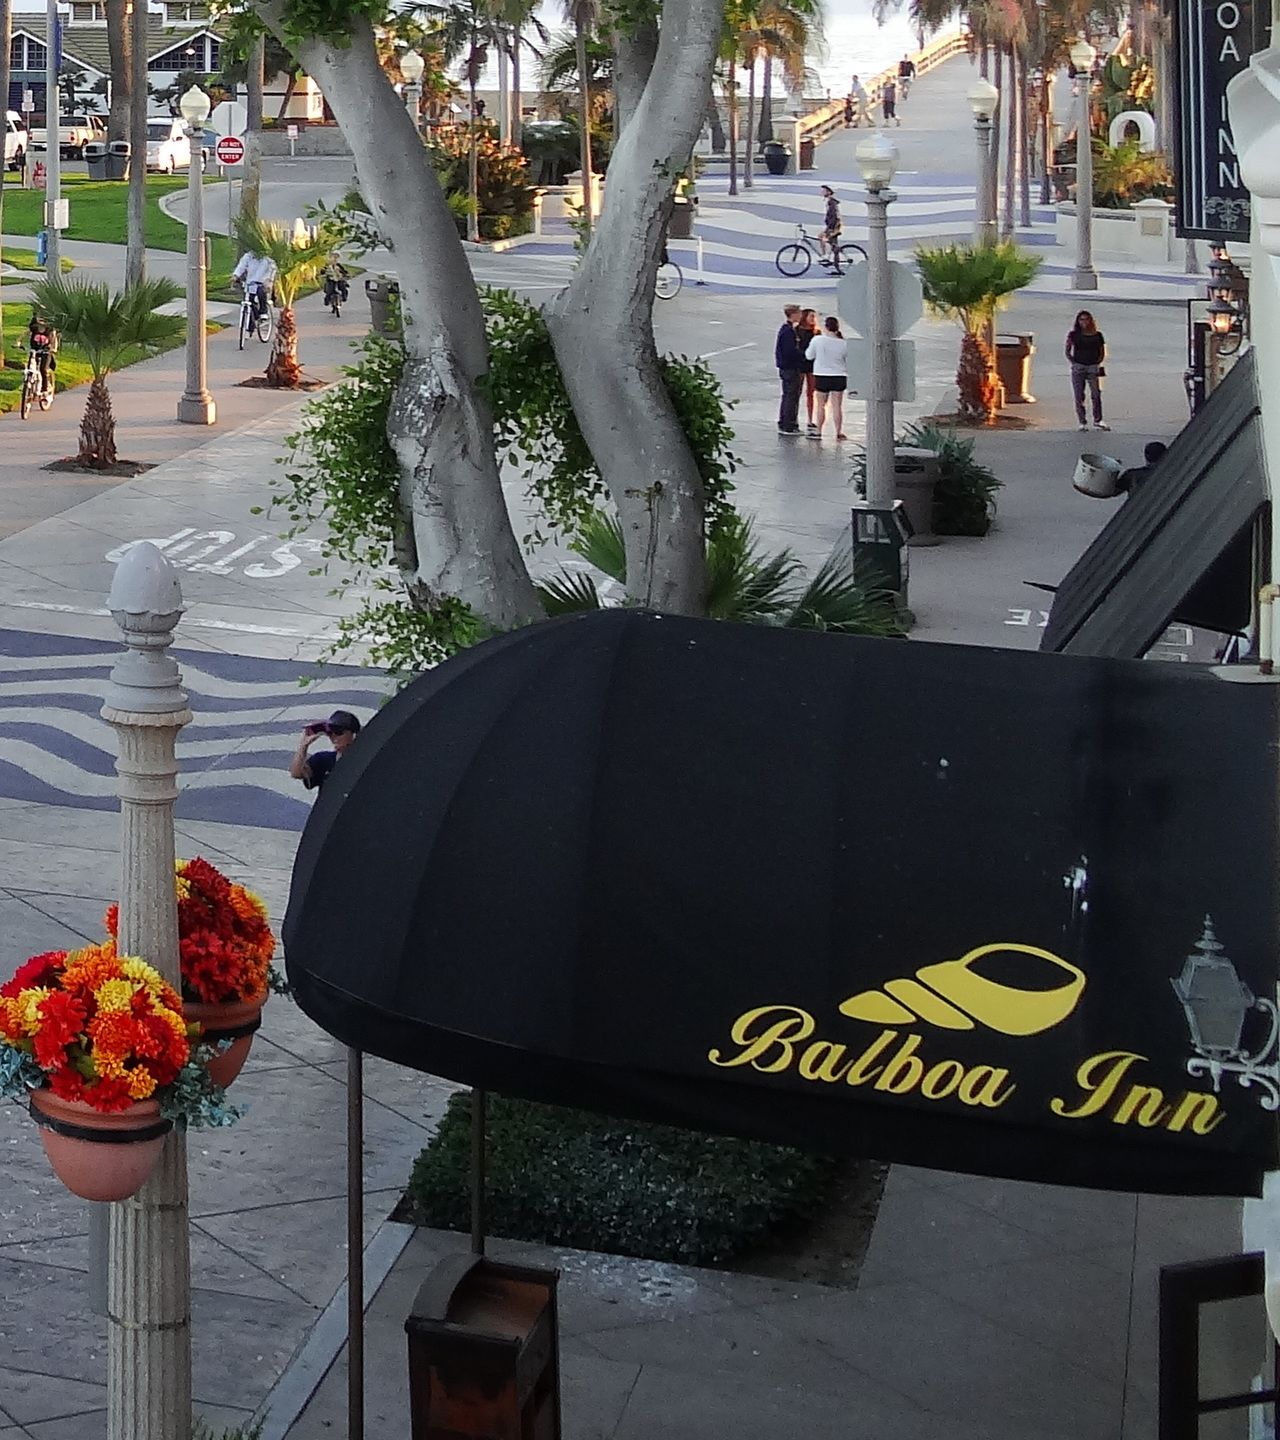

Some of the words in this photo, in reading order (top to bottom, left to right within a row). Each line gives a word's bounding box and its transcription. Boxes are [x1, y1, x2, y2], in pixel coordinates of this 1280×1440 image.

[1218, 95, 1239, 189] INN
[708, 1004, 1016, 1108] Balboa
[1051, 1050, 1226, 1137] Inn
